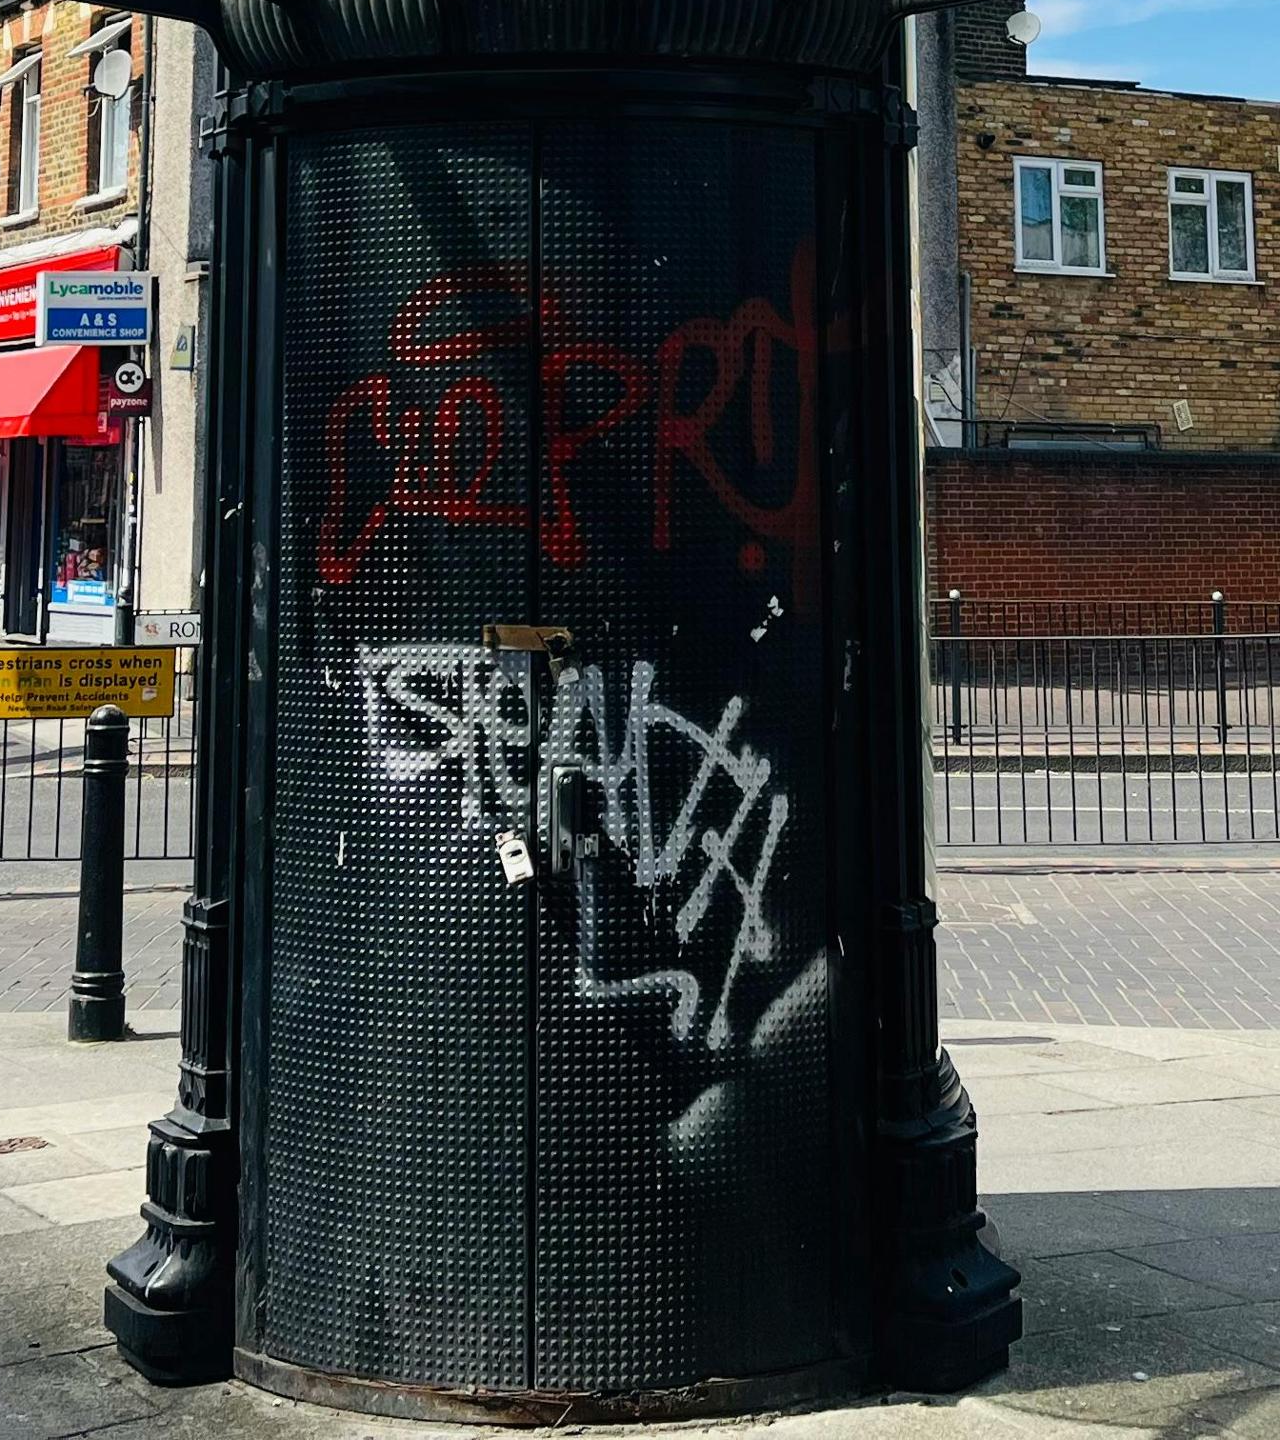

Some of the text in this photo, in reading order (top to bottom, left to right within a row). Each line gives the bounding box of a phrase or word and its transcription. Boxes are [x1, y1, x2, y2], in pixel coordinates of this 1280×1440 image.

[50, 281, 143, 297] Lycamobile
[80, 313, 117, 326] A & S
[52, 328, 144, 337] CONVENIENCE SHOP
[110, 398, 148, 408] payzone
[70, 659, 112, 669] cross
[120, 657, 162, 669] when
[19, 676, 52, 688] man
[59, 674, 72, 687] is
[27, 692, 69, 702] Prevent
[74, 691, 128, 702] Accidents
